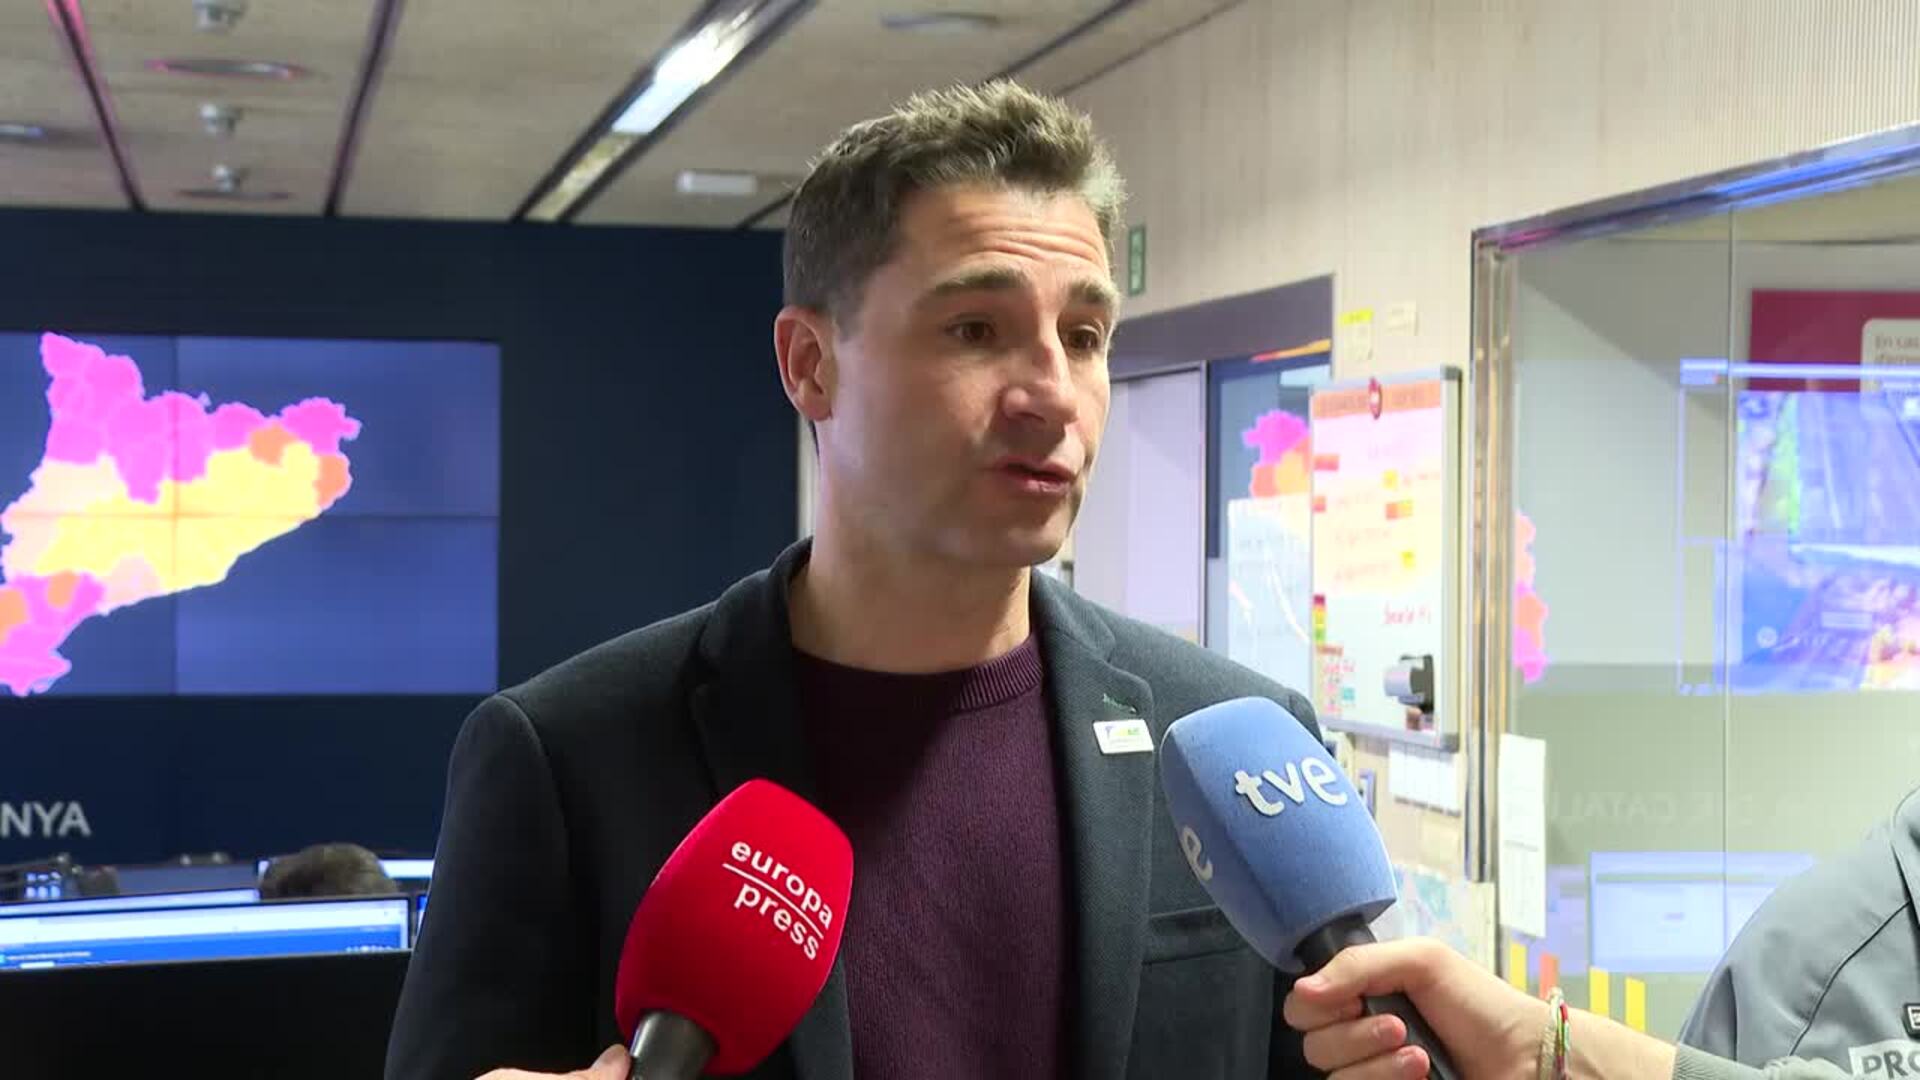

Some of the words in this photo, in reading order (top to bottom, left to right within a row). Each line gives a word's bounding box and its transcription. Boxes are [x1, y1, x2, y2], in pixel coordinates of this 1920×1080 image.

[0, 801, 92, 837] NYA
[1234, 756, 1348, 816] tve
[731, 840, 833, 928] europa
[734, 884, 820, 960] press
